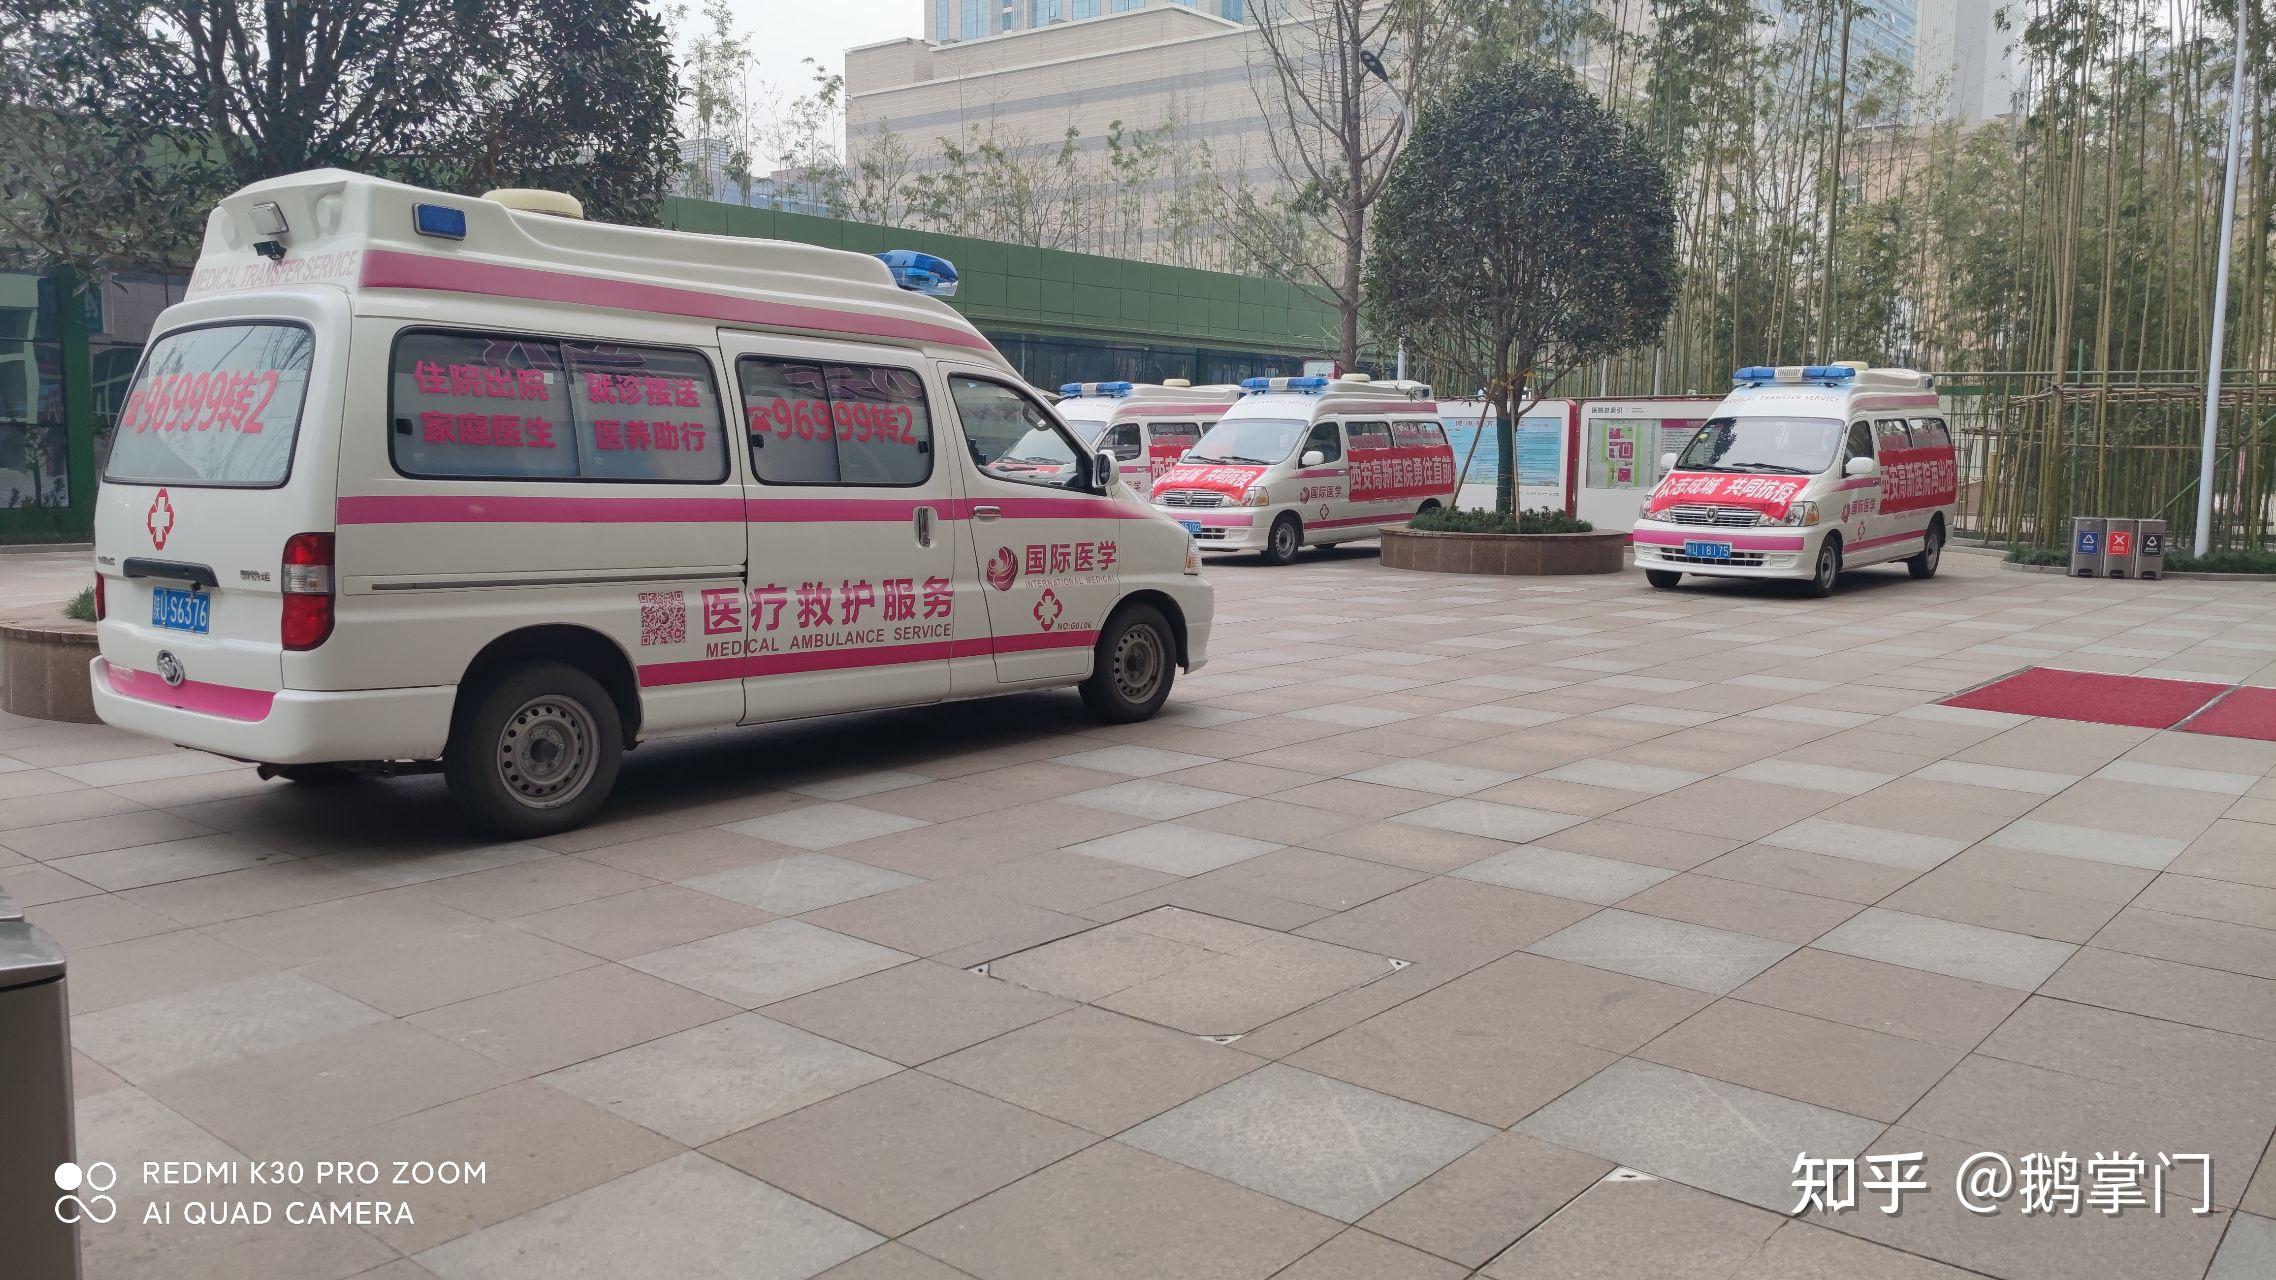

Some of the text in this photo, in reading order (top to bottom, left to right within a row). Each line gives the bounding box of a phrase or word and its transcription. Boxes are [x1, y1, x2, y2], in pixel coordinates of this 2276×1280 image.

[190, 250, 359, 292] MEDICAL TRANSFER SERVICE
[414, 360, 701, 408] 住院出院 就诊接送
[420, 410, 706, 451] 家庭医生 医养助行
[771, 395, 917, 446] 96999转2
[1310, 485, 1343, 499] 国际医学
[1350, 455, 1451, 492] 西安高新医院勇往直前
[1656, 477, 1799, 507] 众志成城 共同抗疫
[1024, 540, 1117, 576] 国际医学
[1025, 574, 1116, 589] INTERNATIONAL MEDICAL
[700, 575, 955, 636] 医疗救护服务
[705, 623, 953, 659] MEDICAL AMBULANCE SERVICE
